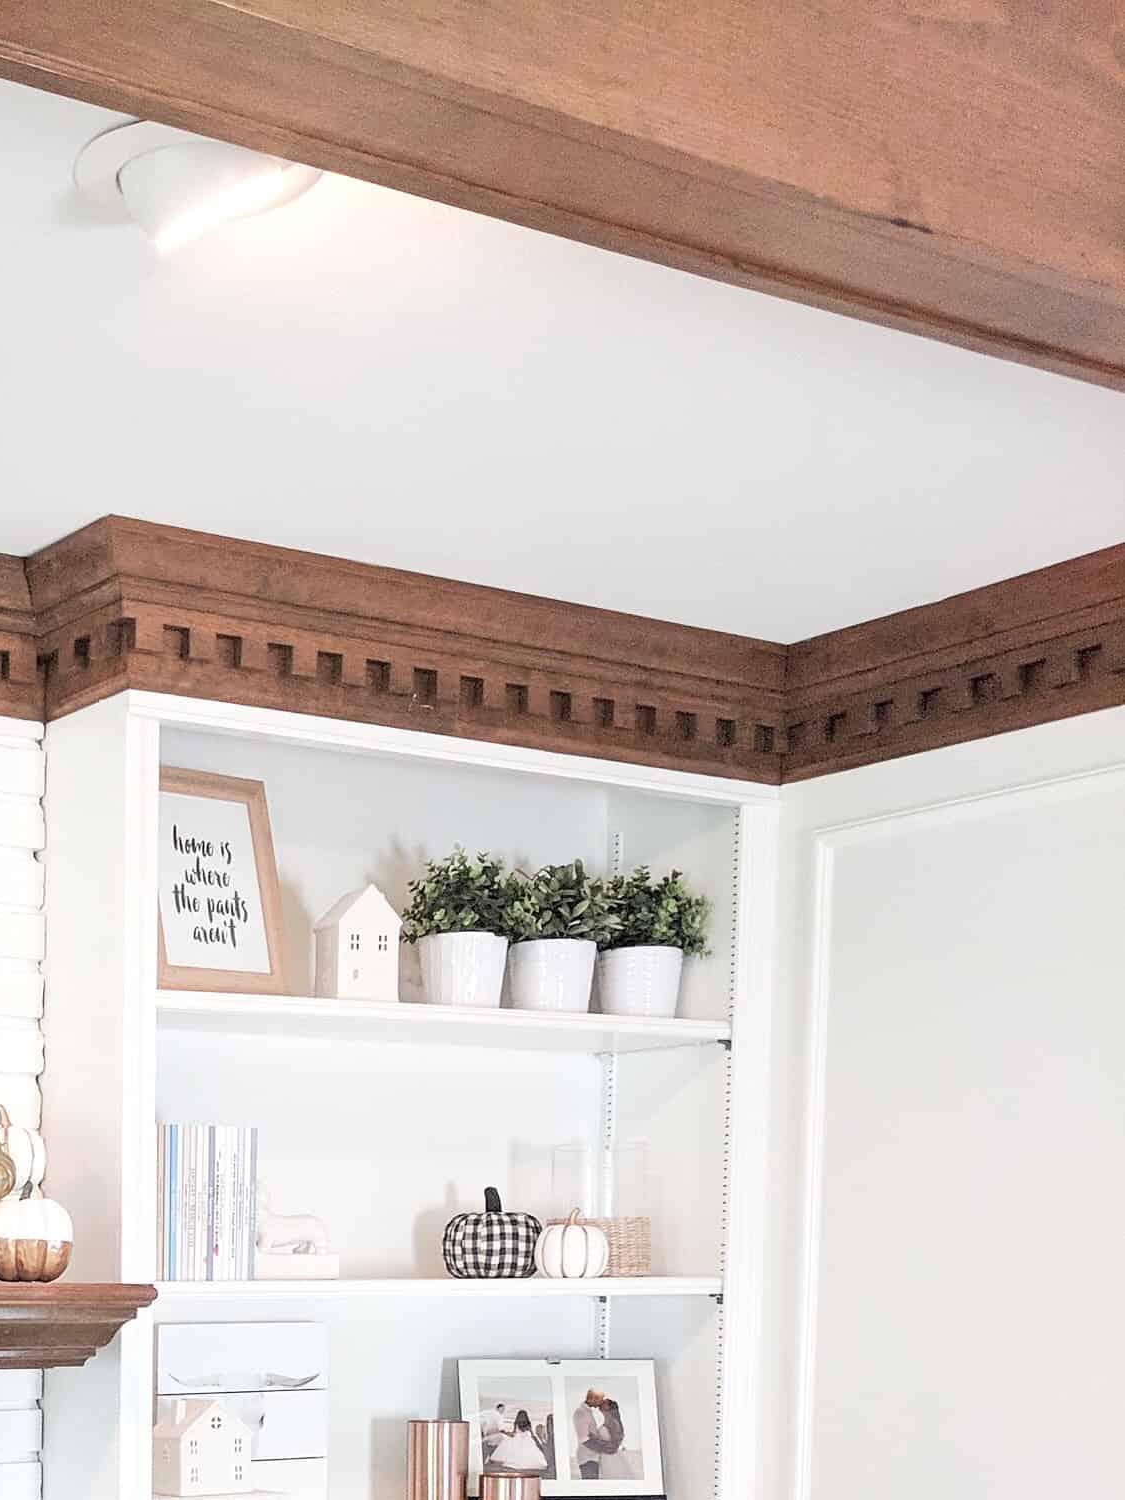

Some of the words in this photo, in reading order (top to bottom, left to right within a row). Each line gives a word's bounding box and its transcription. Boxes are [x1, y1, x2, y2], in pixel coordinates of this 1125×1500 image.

[173, 824, 214, 856] home
[220, 841, 232, 864] is
[185, 856, 230, 887] where
[172, 883, 200, 914] the
[207, 891, 249, 922] pants
[193, 919, 237, 948] aren't
